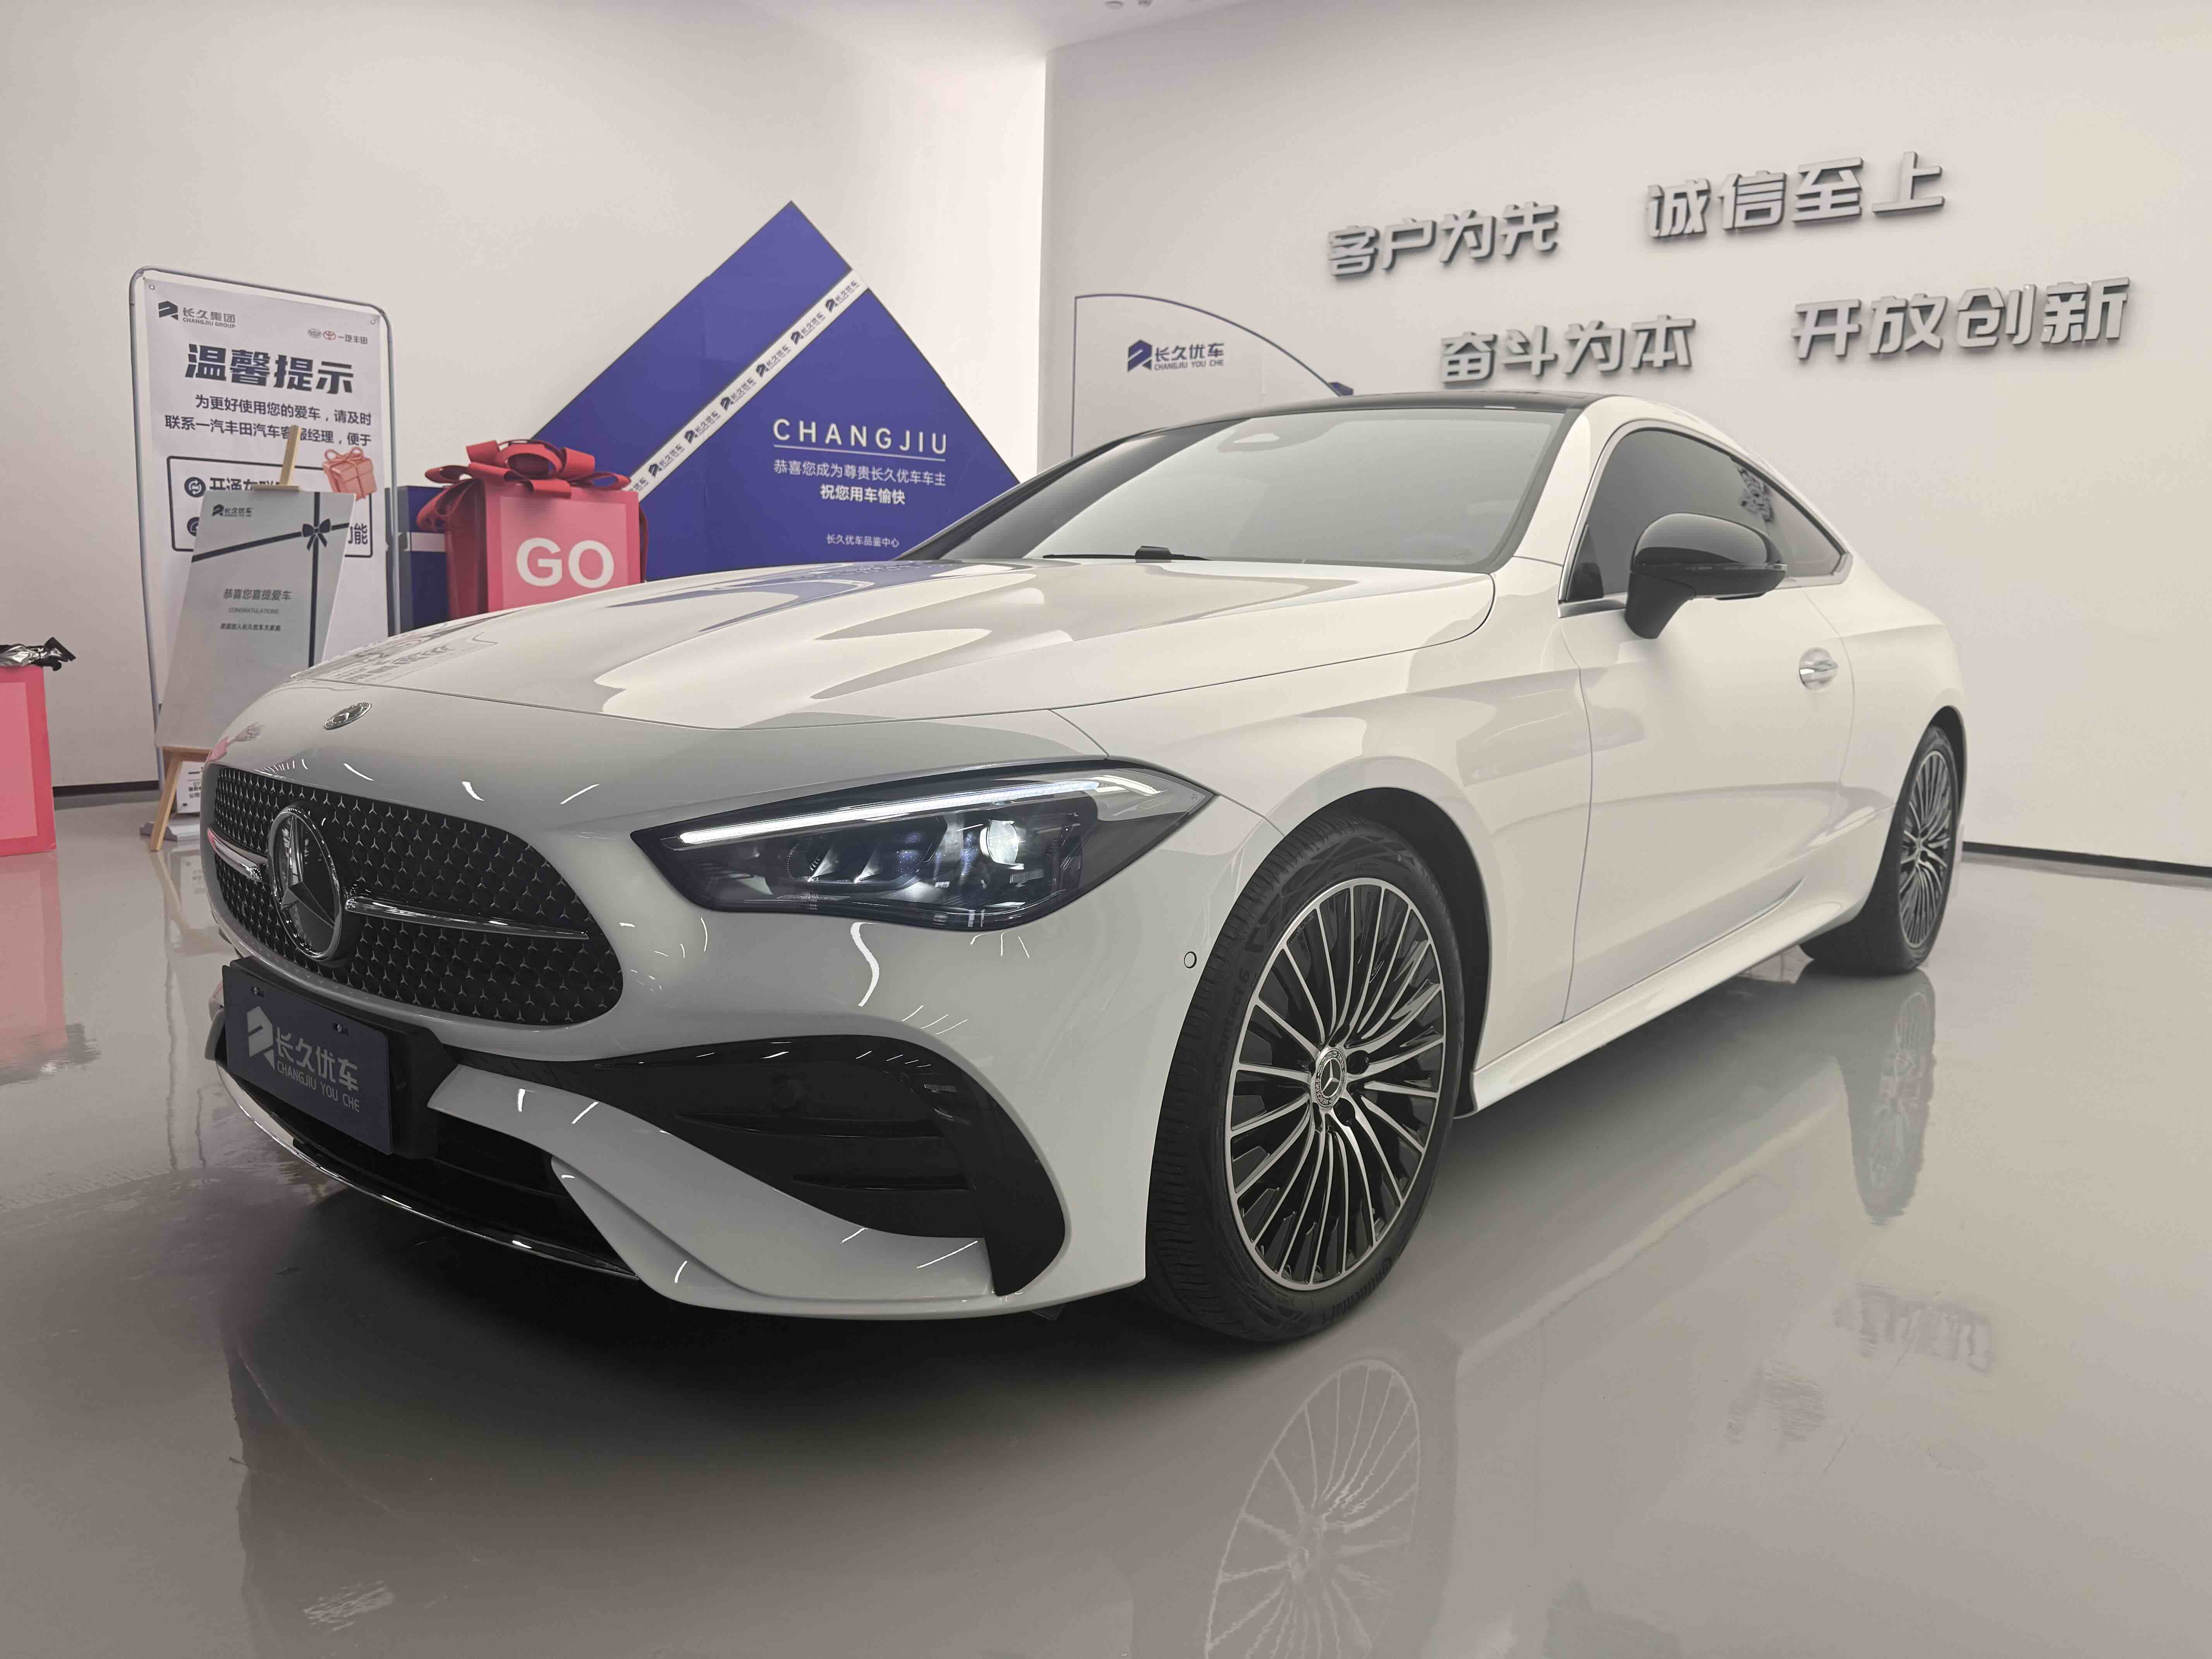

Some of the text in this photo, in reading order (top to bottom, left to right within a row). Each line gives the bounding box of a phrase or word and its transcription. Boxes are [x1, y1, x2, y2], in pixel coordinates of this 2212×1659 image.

[1327, 151, 1945, 278] 客户为先 诚信至上
[182, 307, 236, 324] 长久集团
[182, 317, 213, 326] CHANGJIU
[338, 334, 368, 345] 一汽丰田
[1440, 276, 2130, 385] 奋斗为本 开放创新
[1154, 342, 1224, 362] 长久优车
[1154, 359, 1224, 371] CHANGJIU YOU CHE
[185, 343, 354, 394] 温馨提示
[773, 419, 946, 454] CHANGJIU
[774, 459, 946, 486] 恭喜您成为尊贵长久优车车主
[821, 484, 906, 505] 祝您用车愉快
[827, 534, 900, 548] 长久优车品鉴中心
[516, 537, 614, 589] GO
[223, 588, 292, 601] 恭喜您喜提爱车
[275, 1026, 359, 1092] 长久优车
[277, 1061, 360, 1113] CHANGJIU YOU CHE
[1315, 1077, 1329, 1106] MERCEDES
